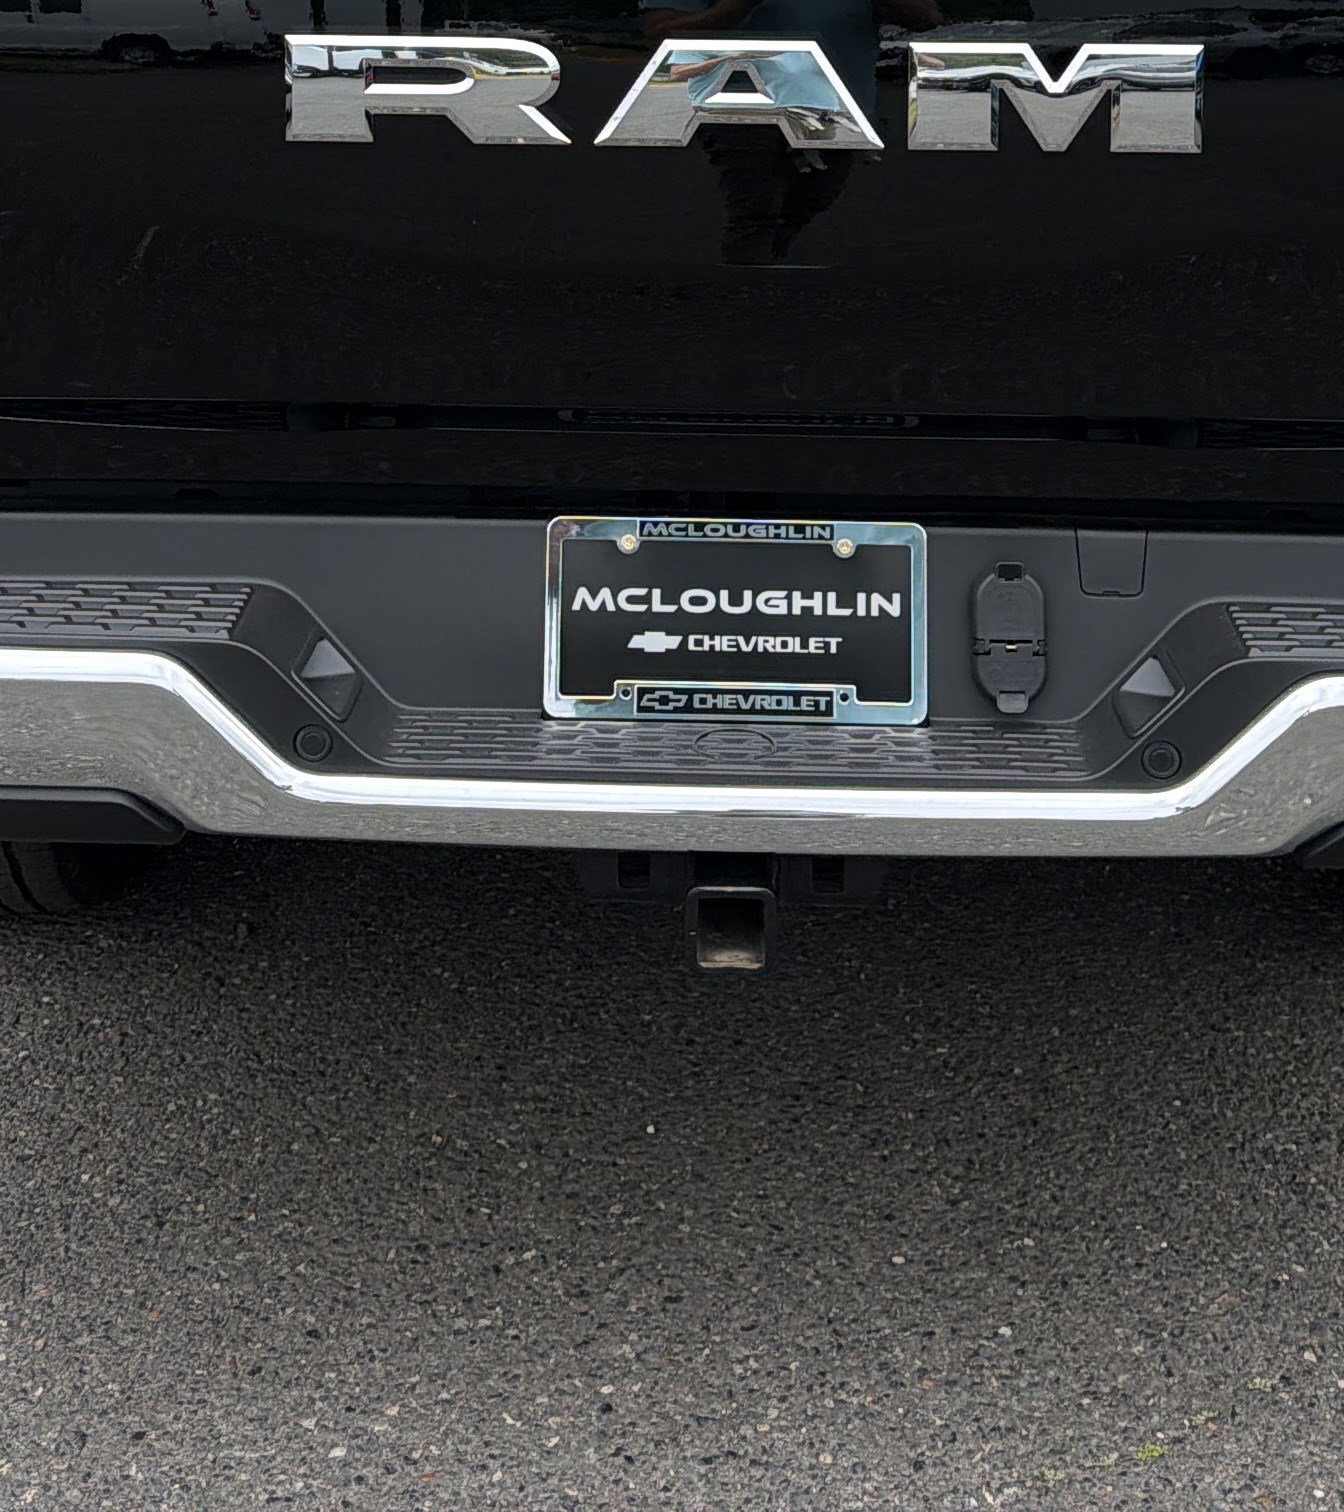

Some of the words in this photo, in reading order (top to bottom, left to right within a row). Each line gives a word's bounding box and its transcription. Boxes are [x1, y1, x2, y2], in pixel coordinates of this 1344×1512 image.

[284, 34, 1207, 155] RAM
[642, 522, 832, 539] MCLOUGHLIN
[571, 586, 902, 618] MCLOUGHLIN
[687, 634, 843, 655] CHEVROLET
[692, 693, 832, 712] CHEVROLET
